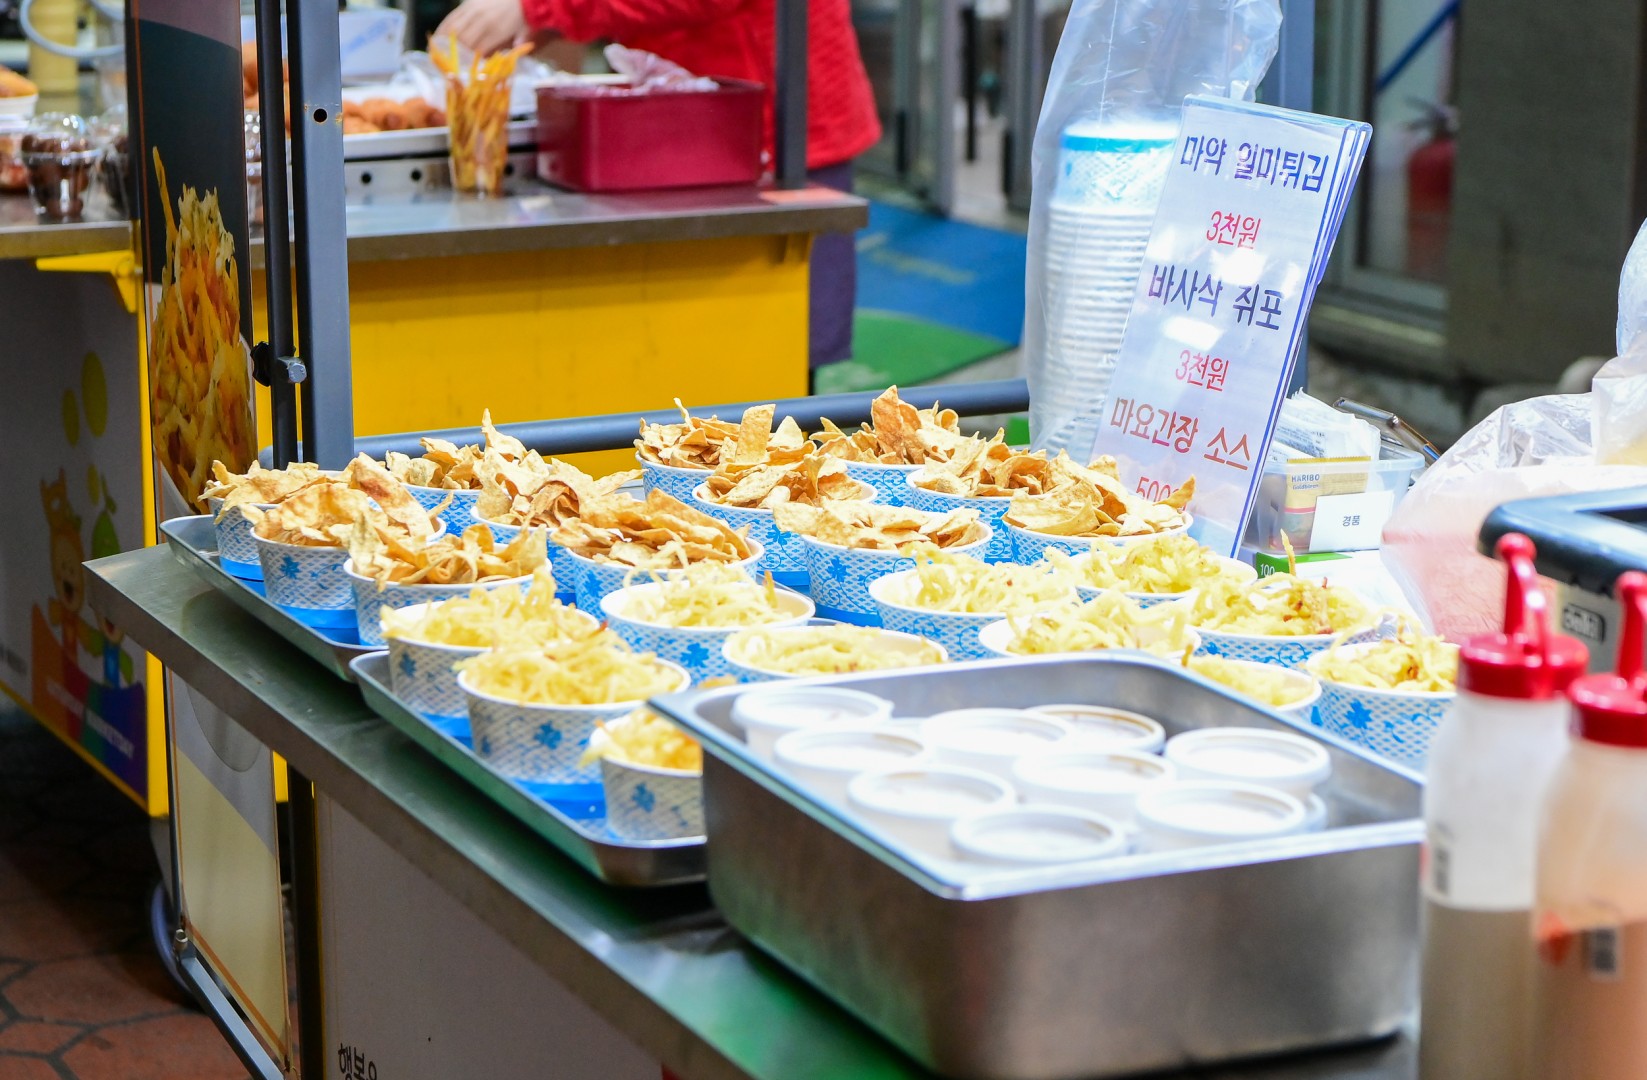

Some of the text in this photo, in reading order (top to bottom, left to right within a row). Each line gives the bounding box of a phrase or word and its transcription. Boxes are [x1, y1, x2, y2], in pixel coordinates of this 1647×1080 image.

[1180, 135, 1330, 194] 마약 일미튀김
[1206, 210, 1262, 250] 3천원
[1148, 264, 1284, 331] 바사삭 쥐포
[1175, 349, 1230, 392] 3천원
[1109, 397, 1199, 454] 마요간장
[1203, 426, 1252, 471] 소스
[1291, 473, 1320, 483] HARIBO
[1342, 515, 1361, 528] 경품
